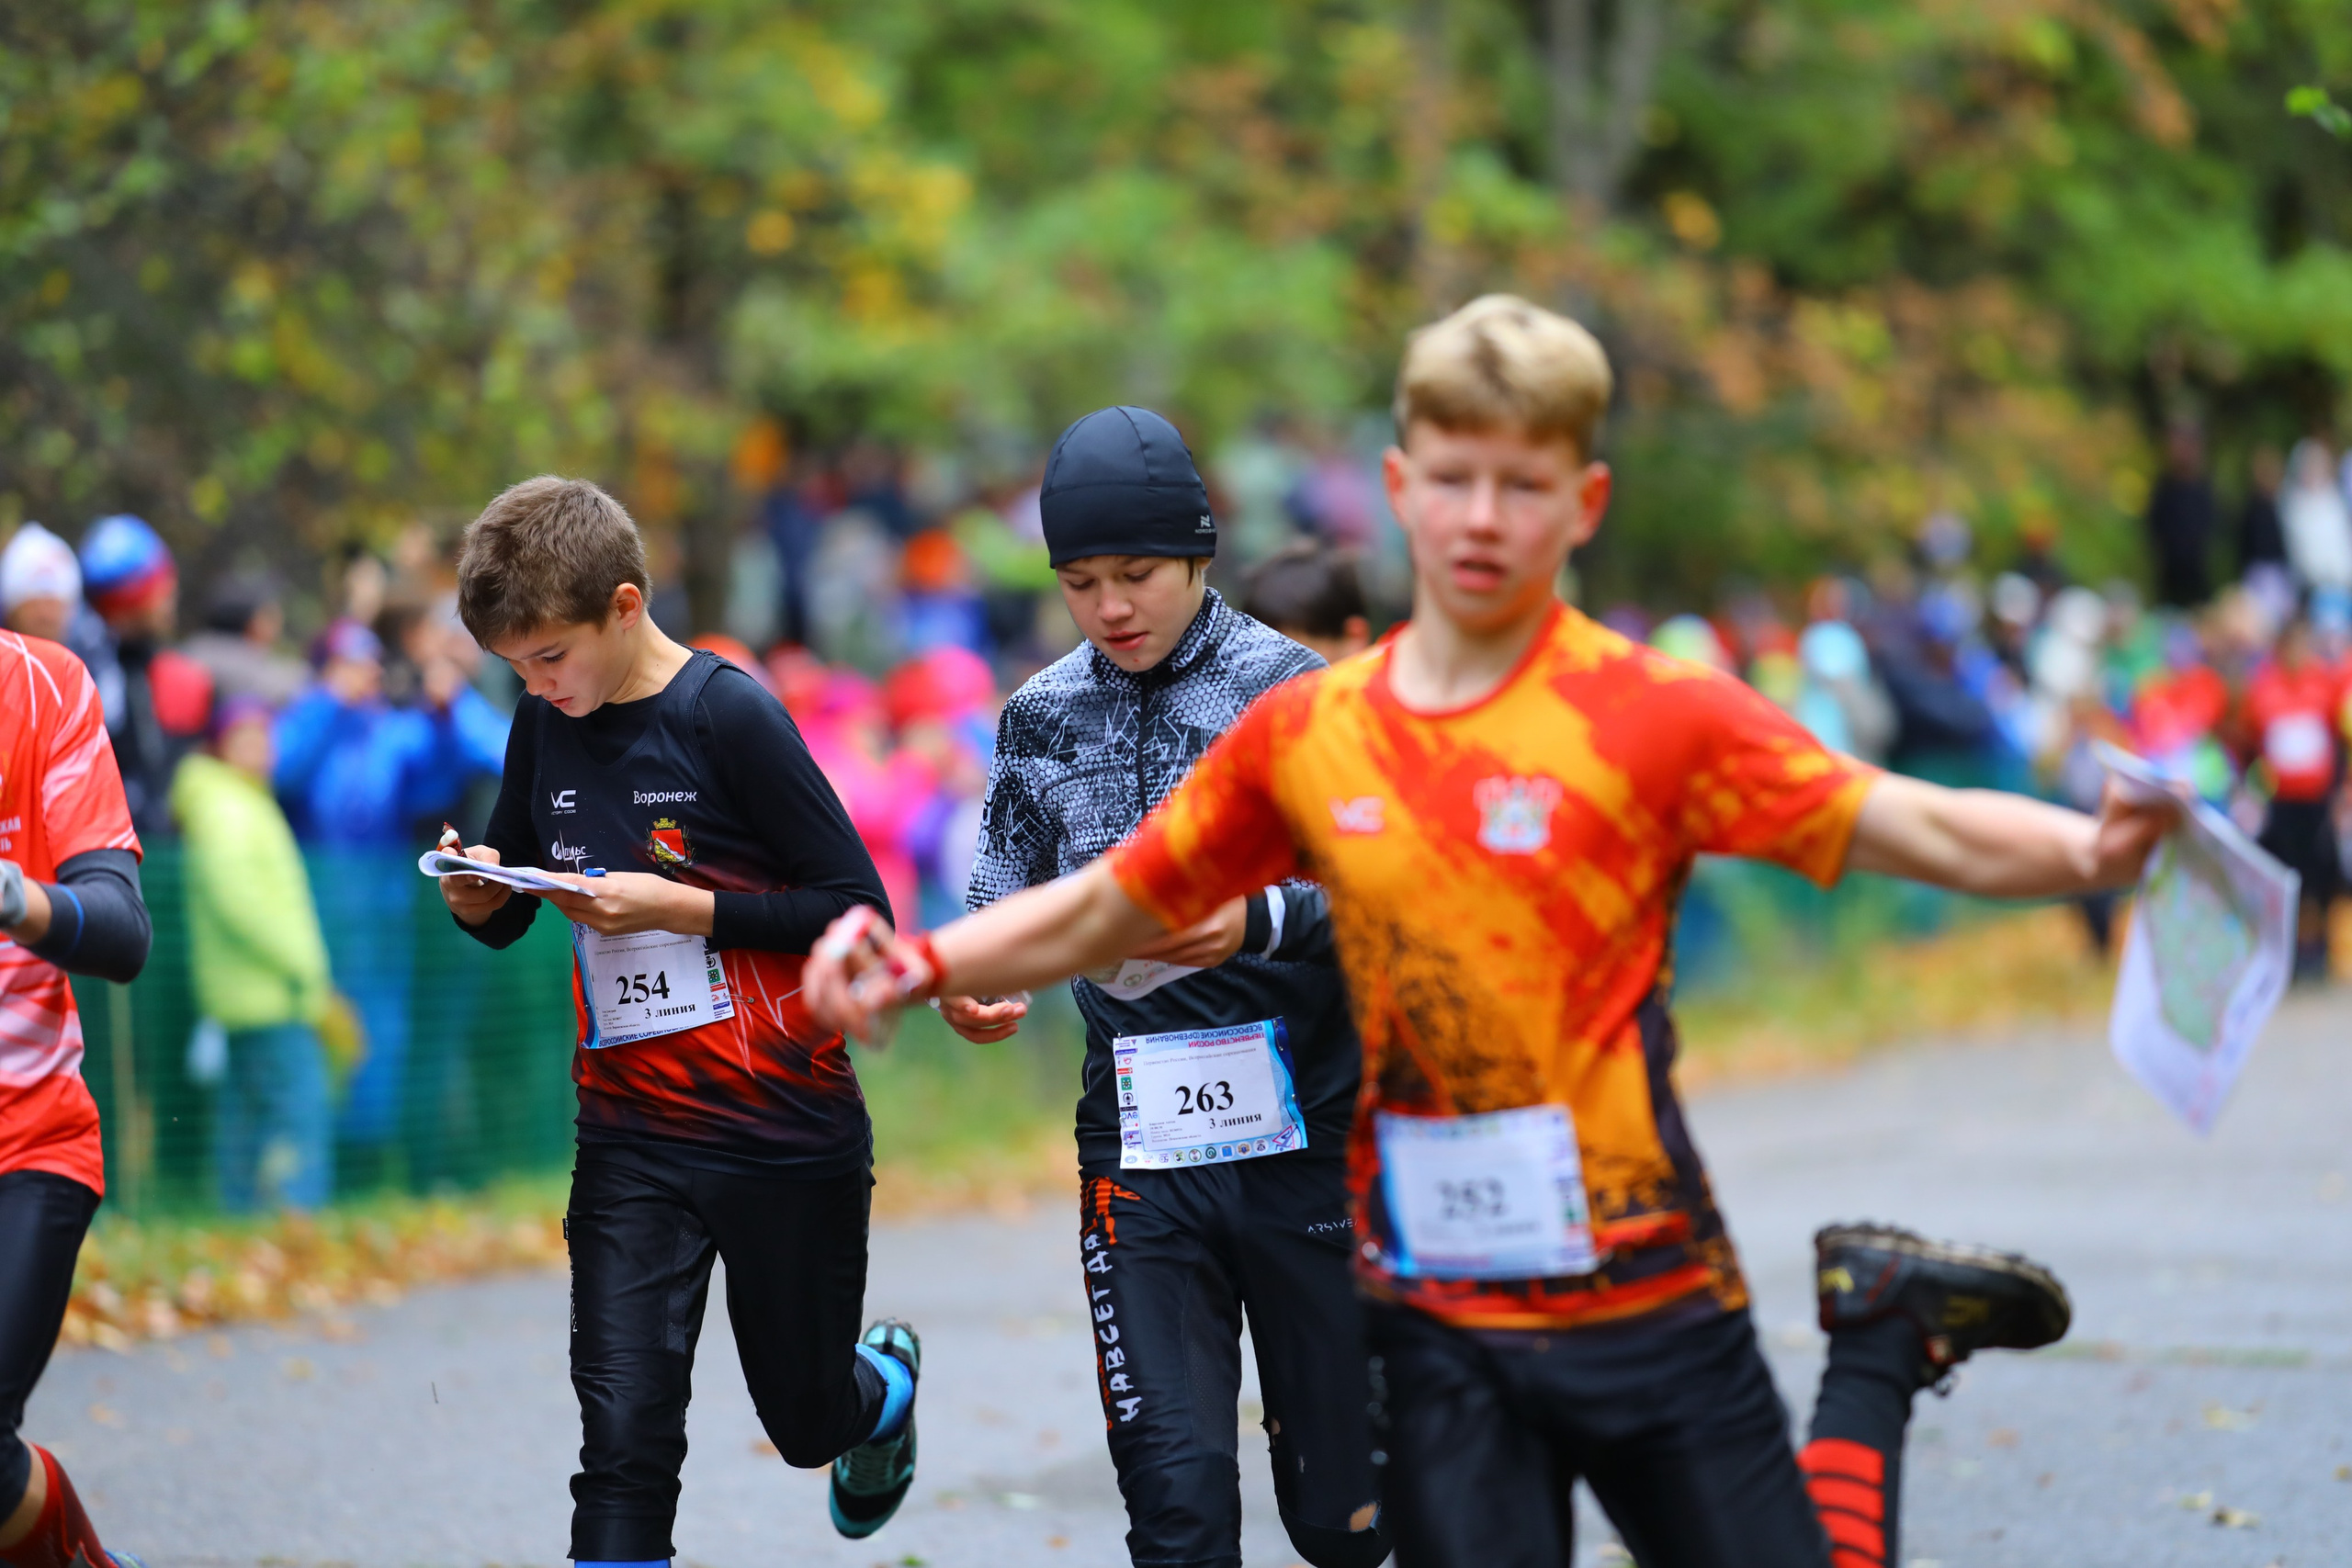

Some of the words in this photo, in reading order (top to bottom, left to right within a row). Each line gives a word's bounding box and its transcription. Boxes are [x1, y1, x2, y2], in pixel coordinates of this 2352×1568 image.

[633, 790, 697, 807] Воронеж
[616, 970, 671, 1005] 254
[645, 1008, 651, 1020] 3
[655, 1003, 696, 1018] линия
[1216, 1032, 1265, 1047] ПЕРВЕНСТВО
[1175, 1080, 1235, 1116] 263
[1209, 1117, 1216, 1130] 3
[1220, 1113, 1262, 1129] линия
[1082, 1233, 1144, 1424] НАВСЕГДА
